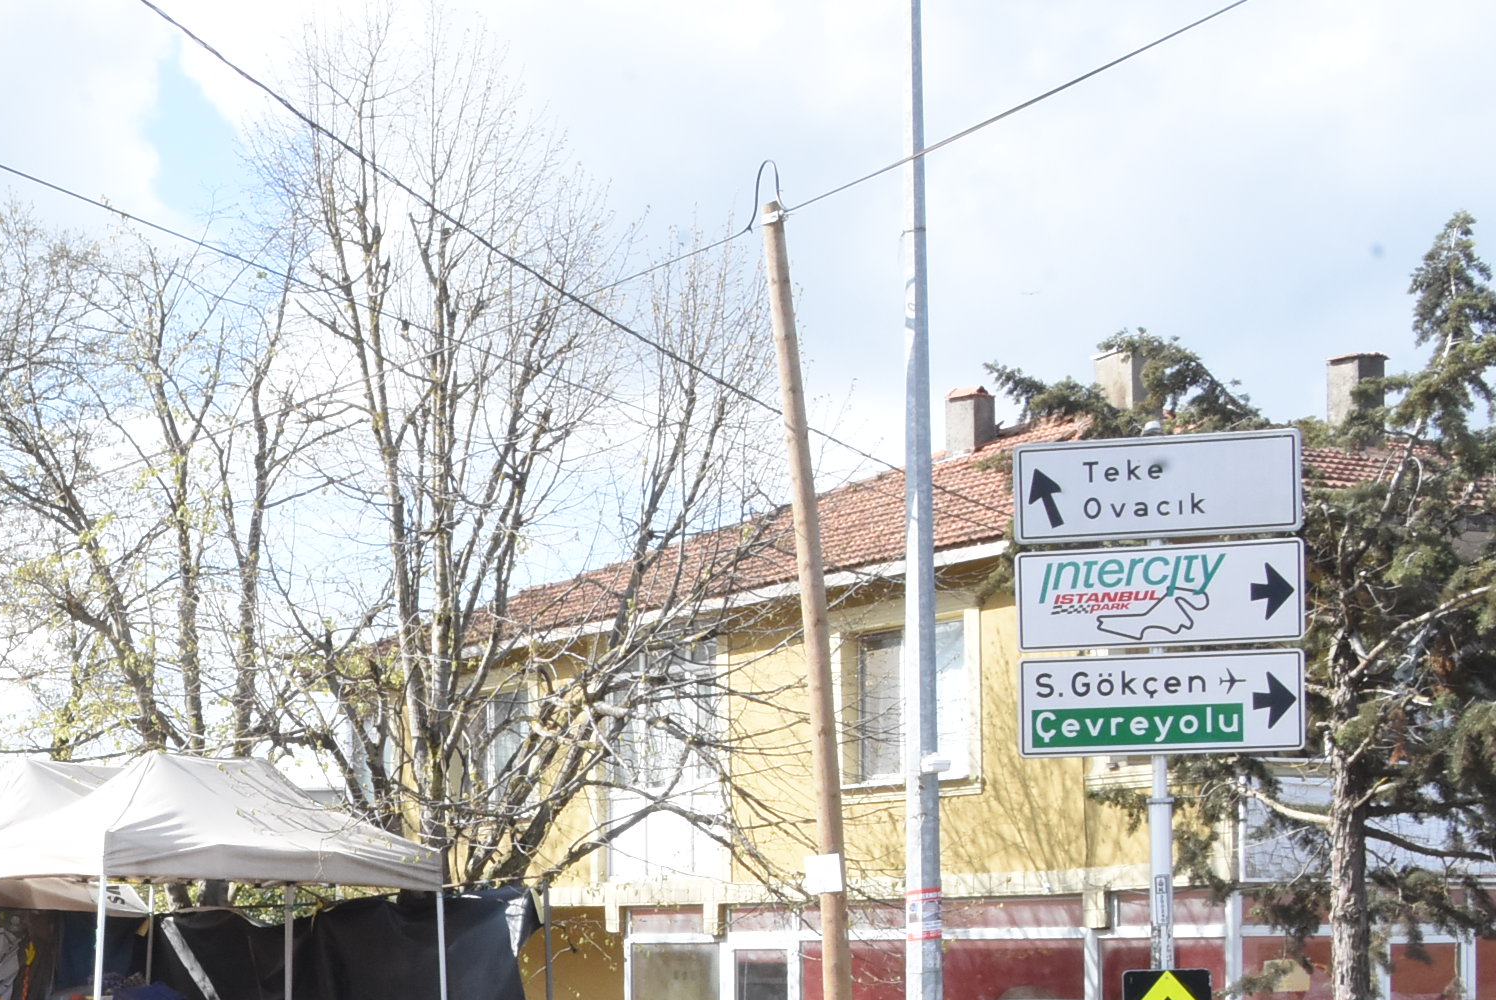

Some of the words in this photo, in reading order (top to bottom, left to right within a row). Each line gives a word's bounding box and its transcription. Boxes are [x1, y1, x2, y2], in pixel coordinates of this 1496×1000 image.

[1082, 460, 1163, 483] Teke
[1083, 493, 1206, 519] Ovacık
[1054, 590, 1161, 605] ISTANBUL
[1035, 670, 1206, 699] S.Gökçen
[1035, 707, 1239, 743] Çevreyolu
